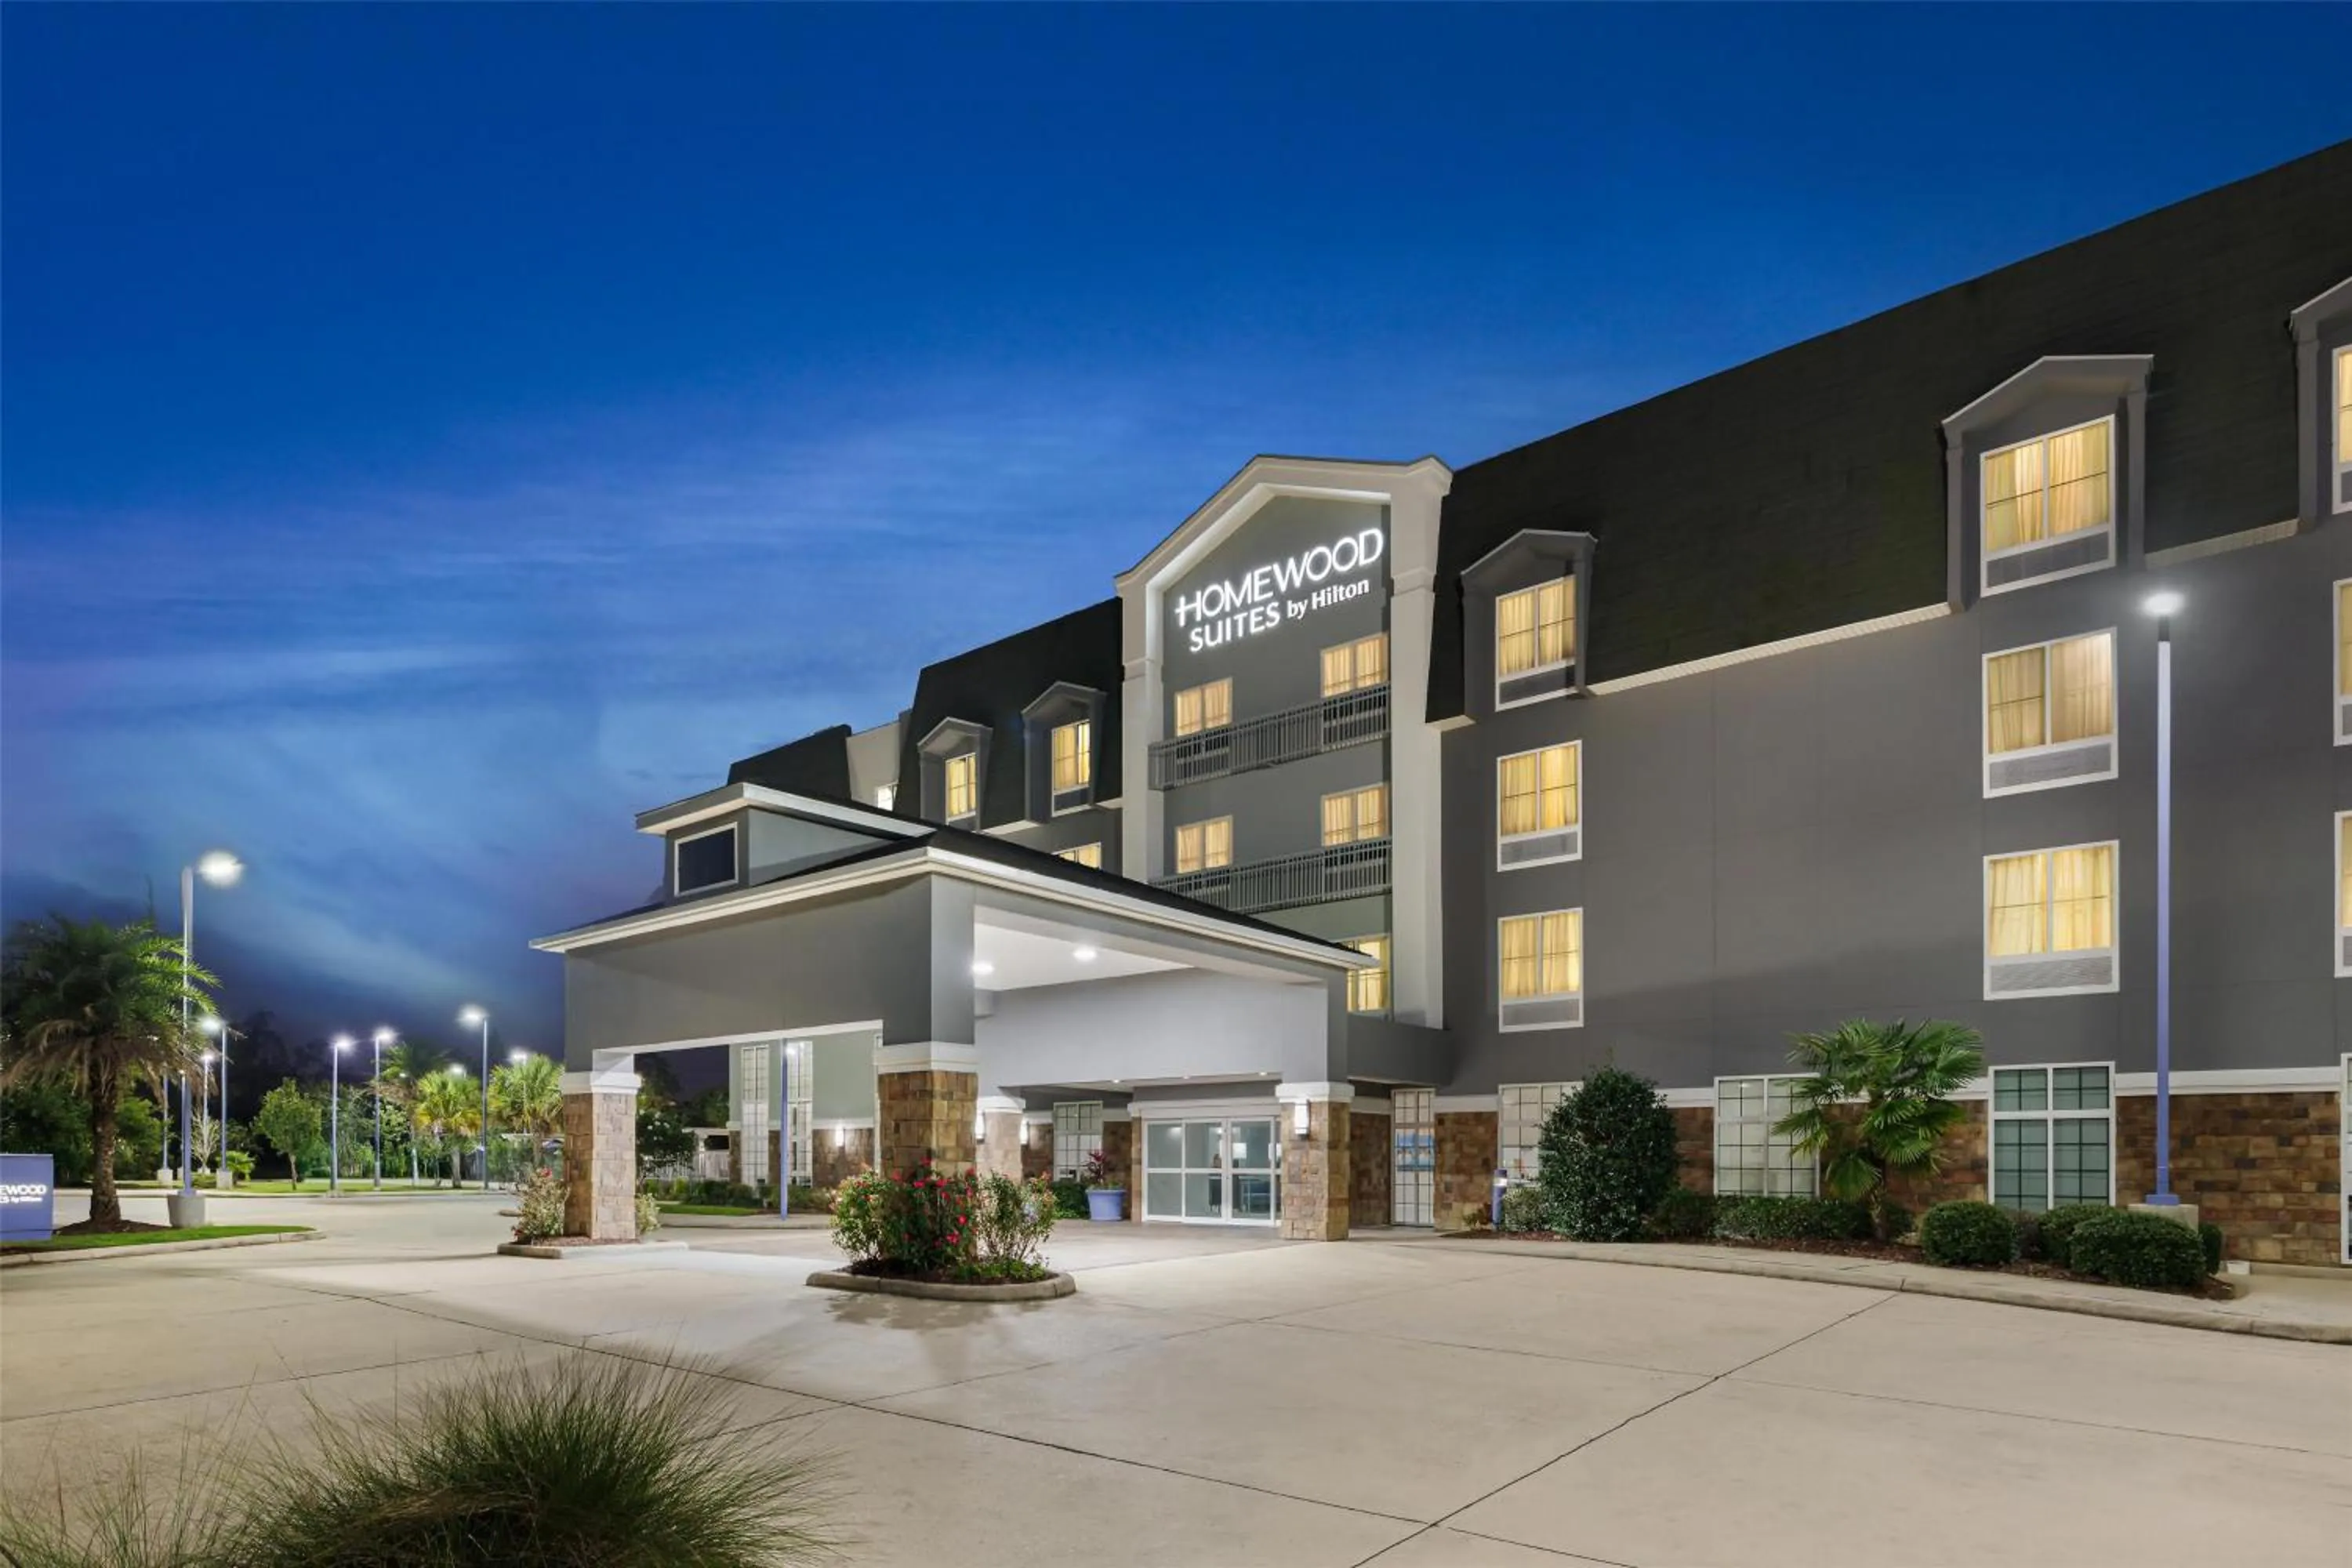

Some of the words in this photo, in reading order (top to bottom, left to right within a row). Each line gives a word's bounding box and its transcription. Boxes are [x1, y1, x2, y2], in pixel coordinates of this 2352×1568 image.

[1174, 528, 1384, 627] HOMEWOOD
[1189, 601, 1281, 652] SUITES
[1287, 599, 1308, 619] by
[1311, 579, 1370, 610] Hilton
